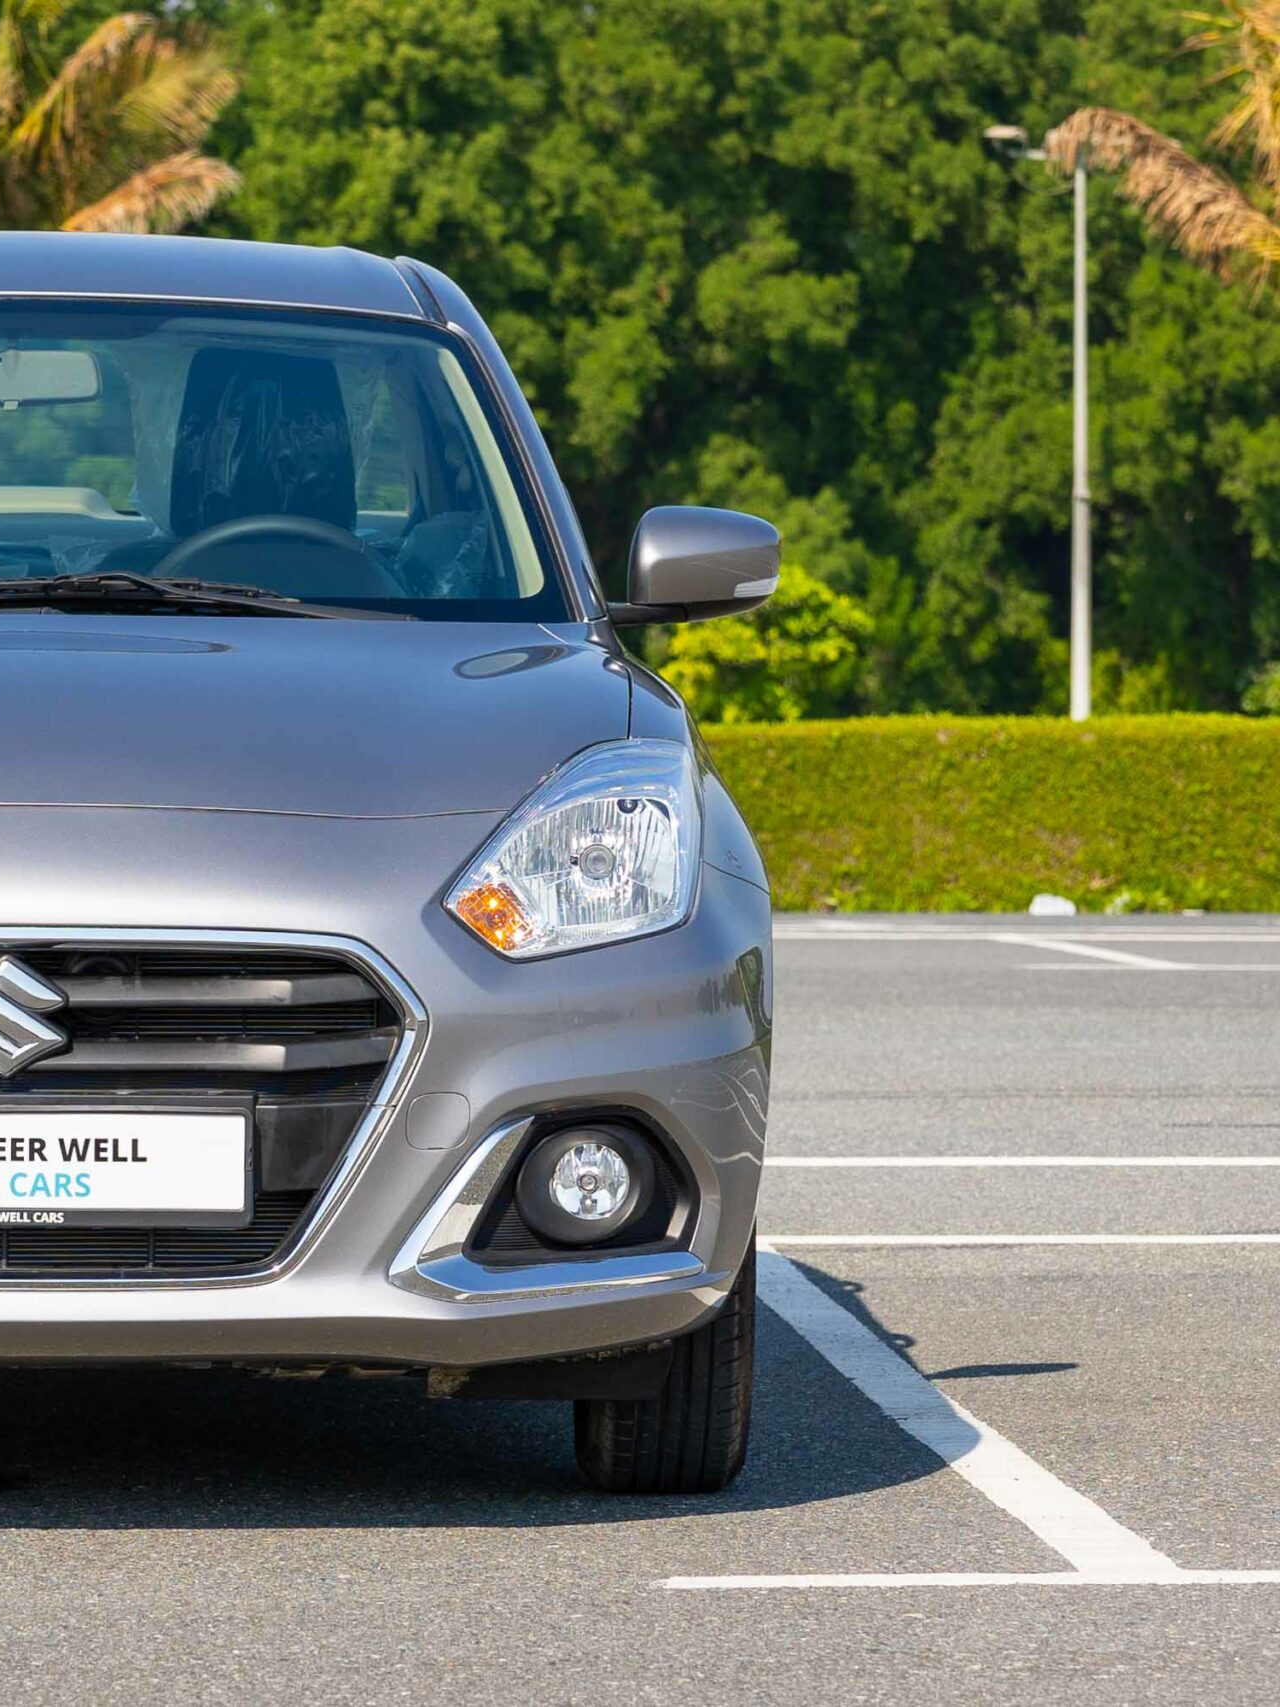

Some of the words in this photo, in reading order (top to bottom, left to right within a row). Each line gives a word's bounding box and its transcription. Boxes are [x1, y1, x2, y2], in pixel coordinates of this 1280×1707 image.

[58, 1138, 148, 1163] WELL
[9, 1172, 92, 1198] CARS
[32, 1212, 65, 1224] CARS
